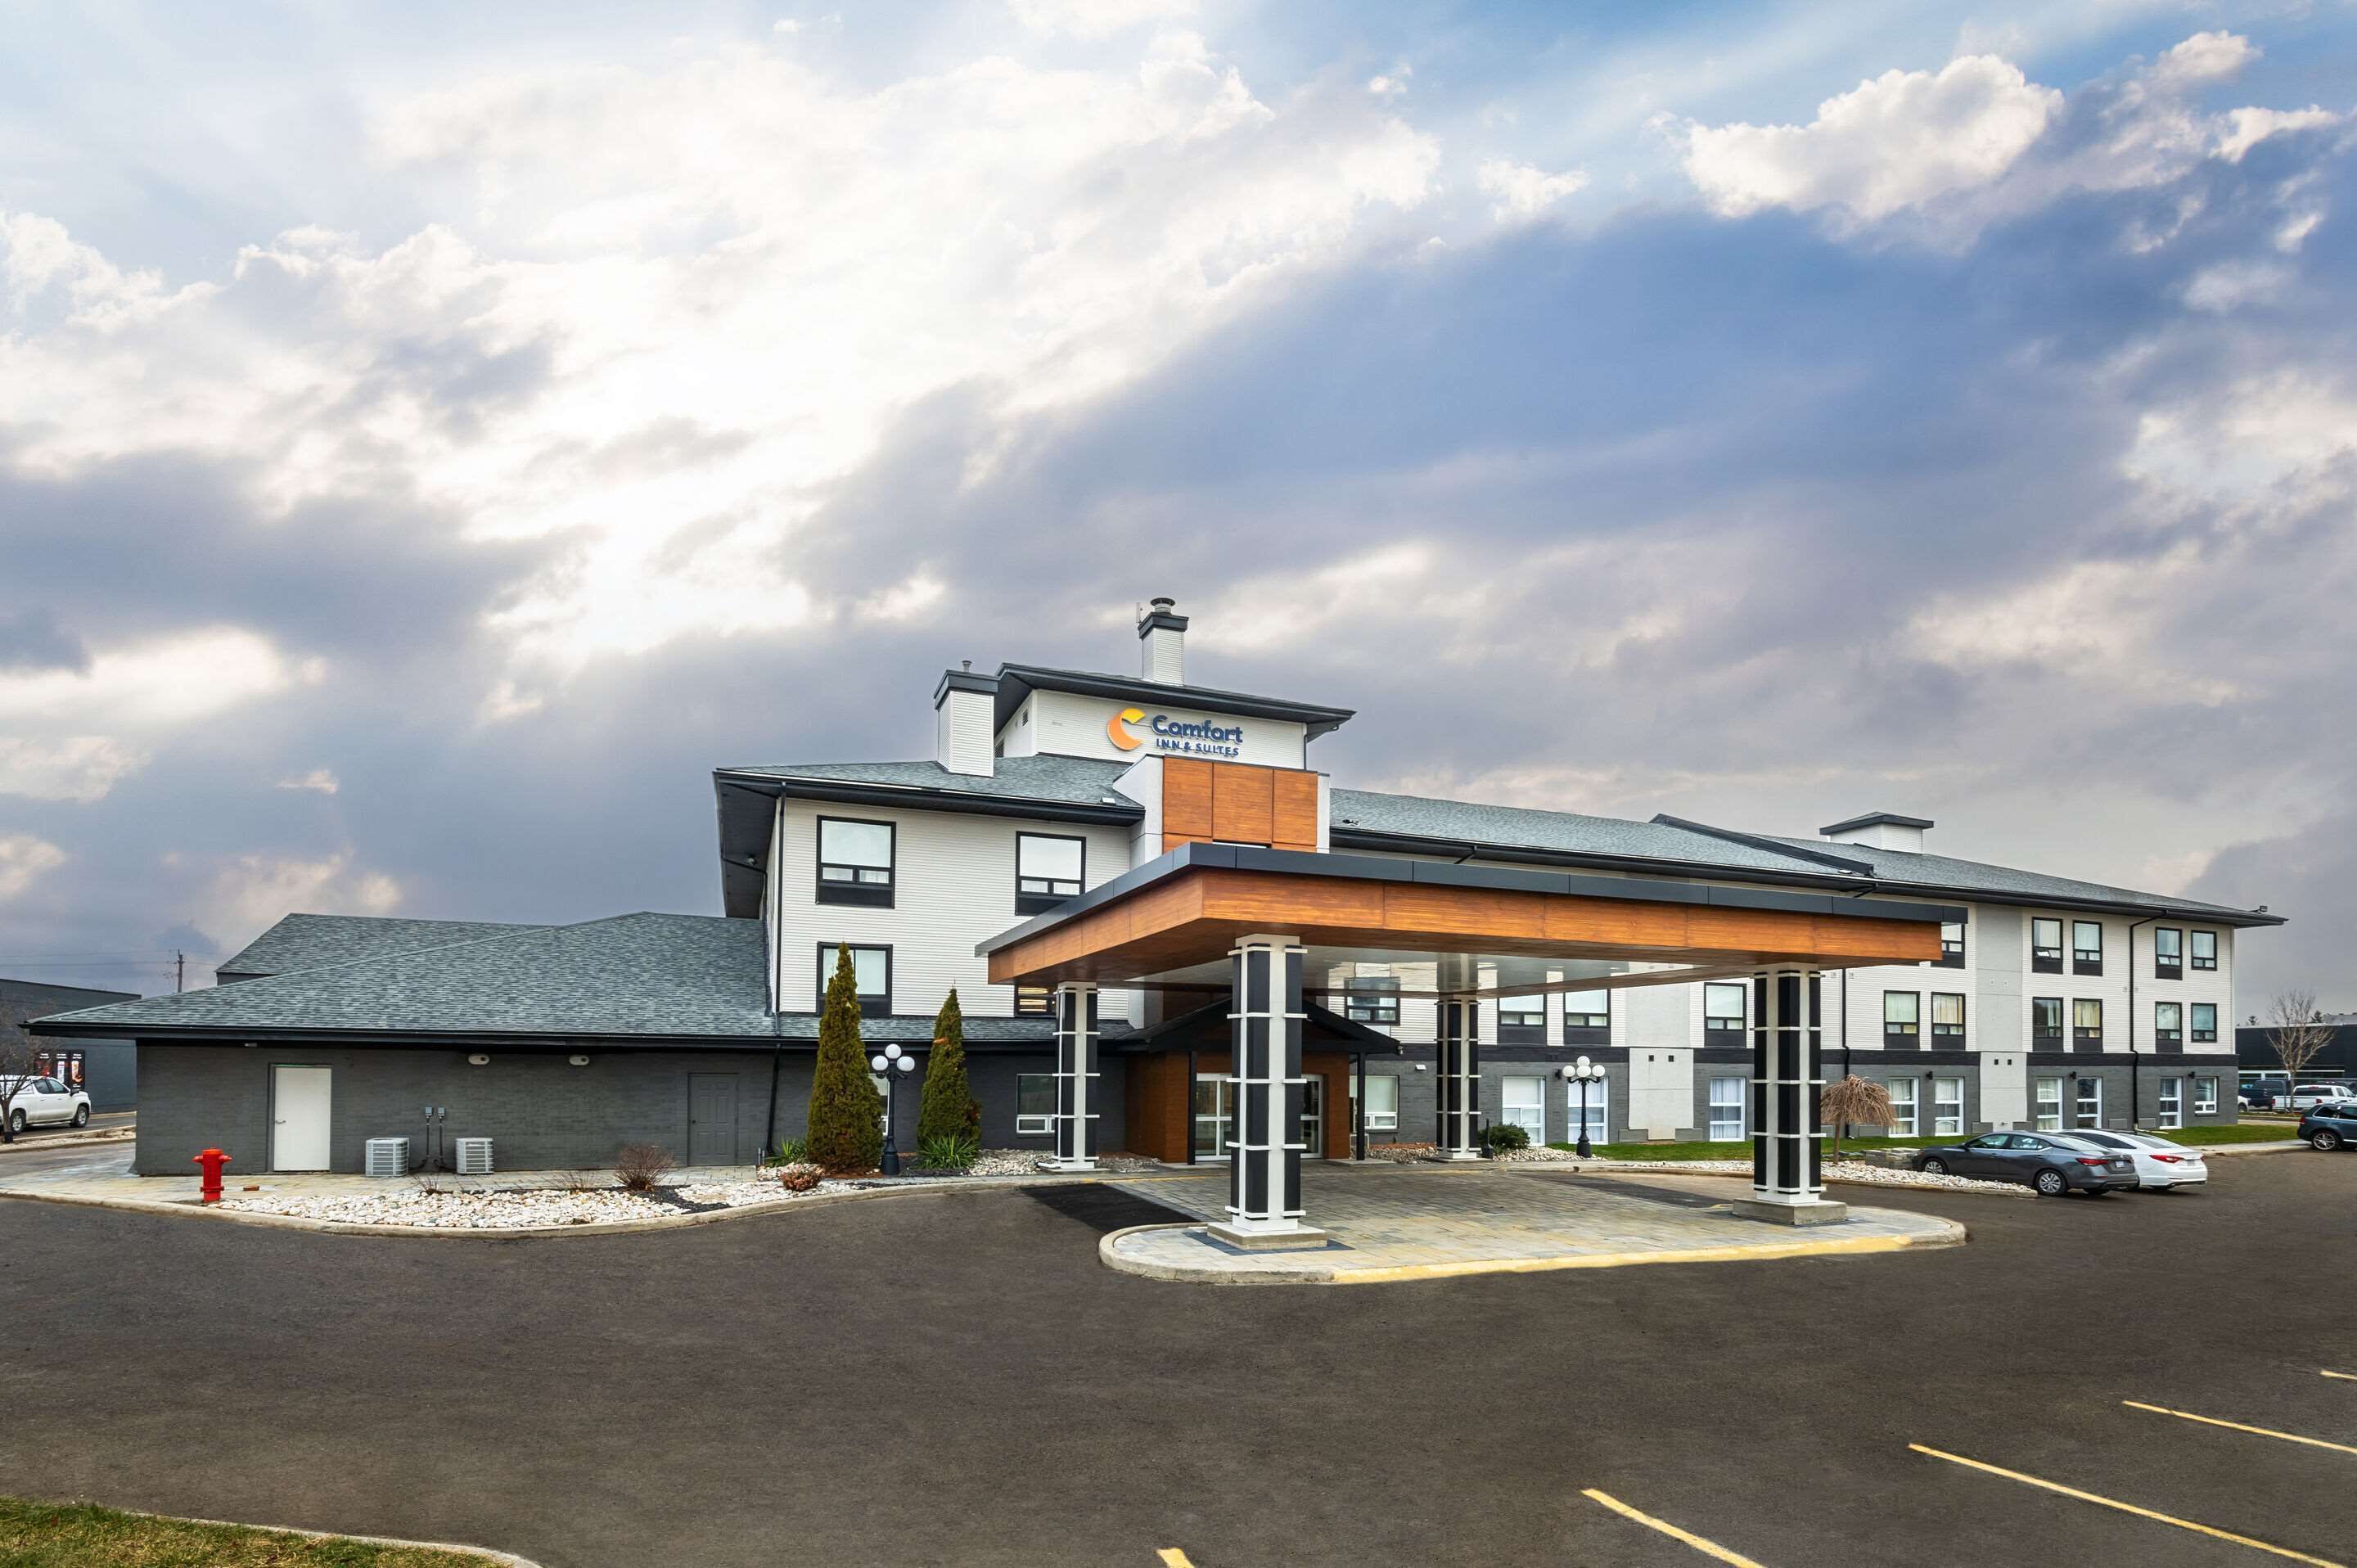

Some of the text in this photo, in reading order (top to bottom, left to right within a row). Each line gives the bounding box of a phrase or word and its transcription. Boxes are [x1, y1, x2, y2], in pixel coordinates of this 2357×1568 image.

[1151, 714, 1243, 743] Comfort
[1156, 738, 1239, 756] INN & SUITES
